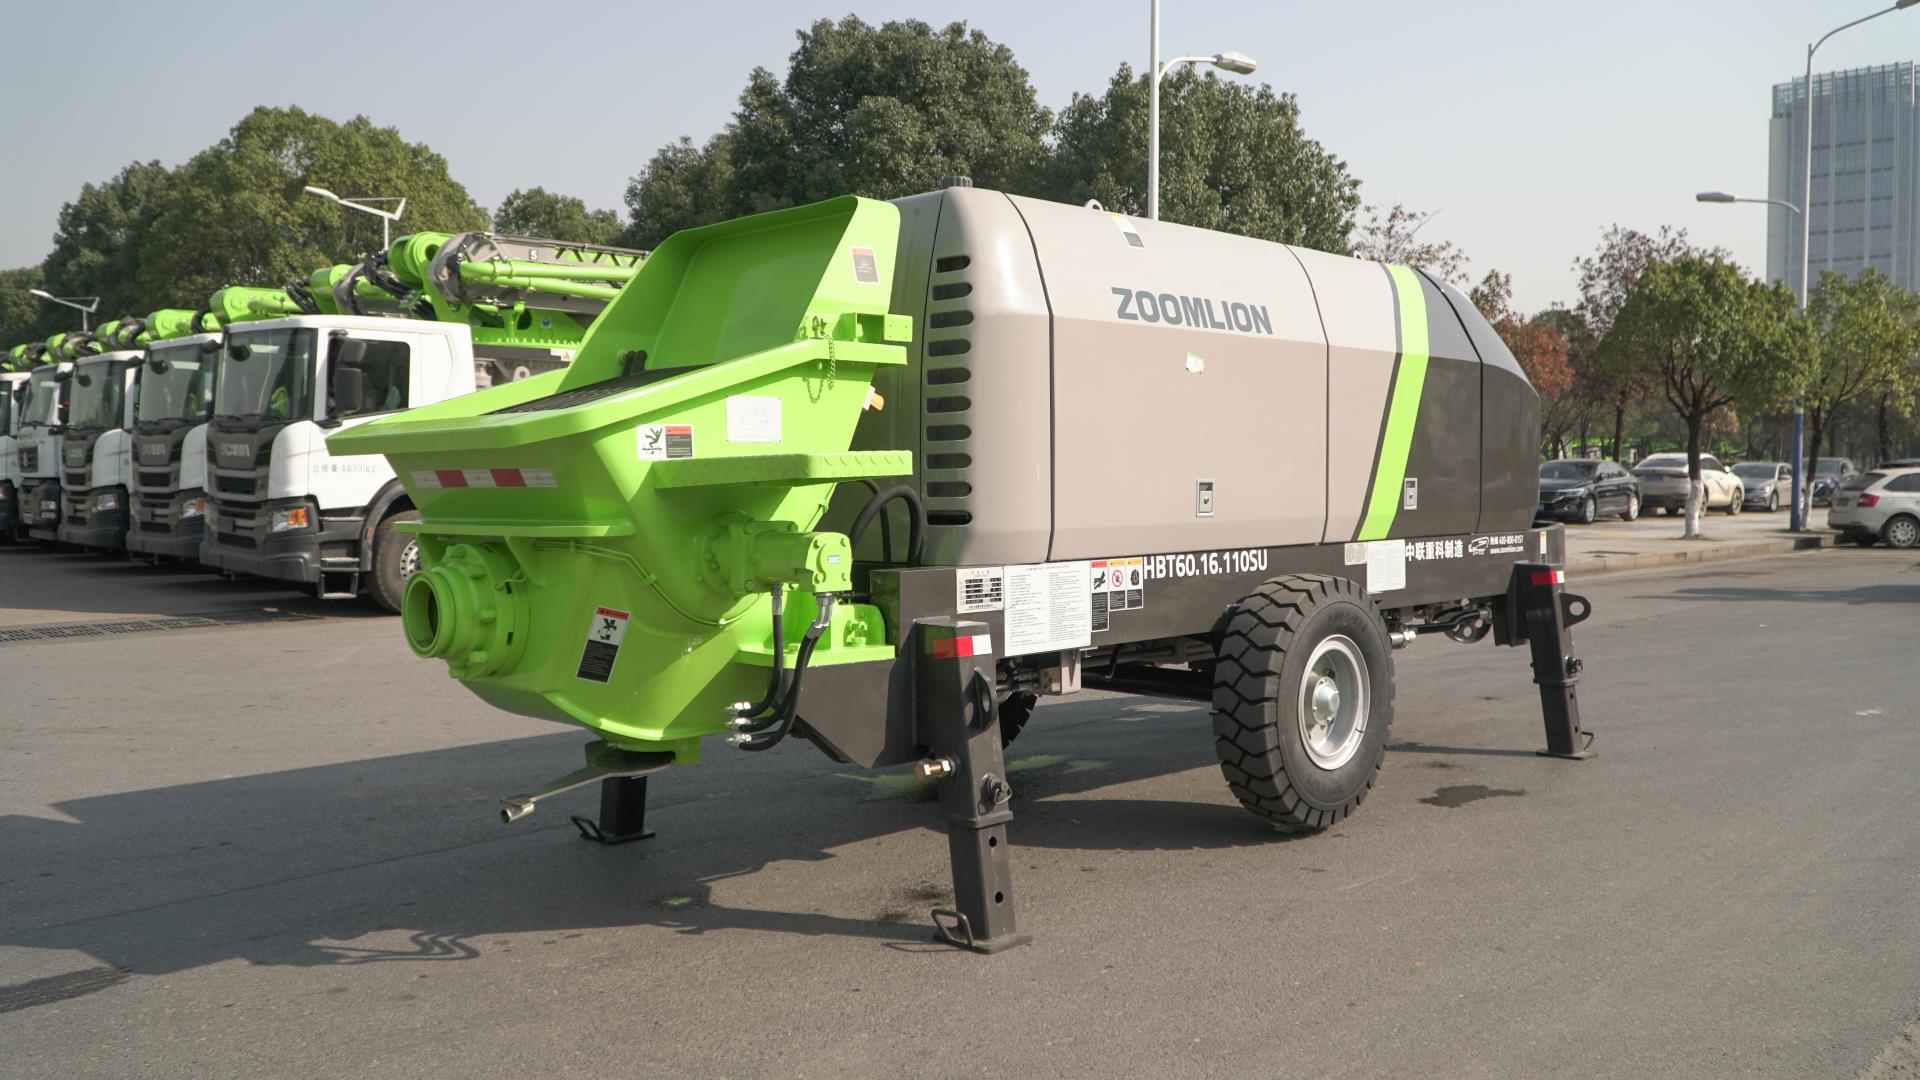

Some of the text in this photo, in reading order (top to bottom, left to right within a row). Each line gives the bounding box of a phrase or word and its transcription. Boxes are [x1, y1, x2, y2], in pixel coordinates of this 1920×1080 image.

[531, 250, 538, 260] 5
[1111, 286, 1273, 335] ZOOMLION
[1405, 539, 1463, 562] 中联重科制造
[1143, 549, 1268, 580] HBT60.16.110SU
